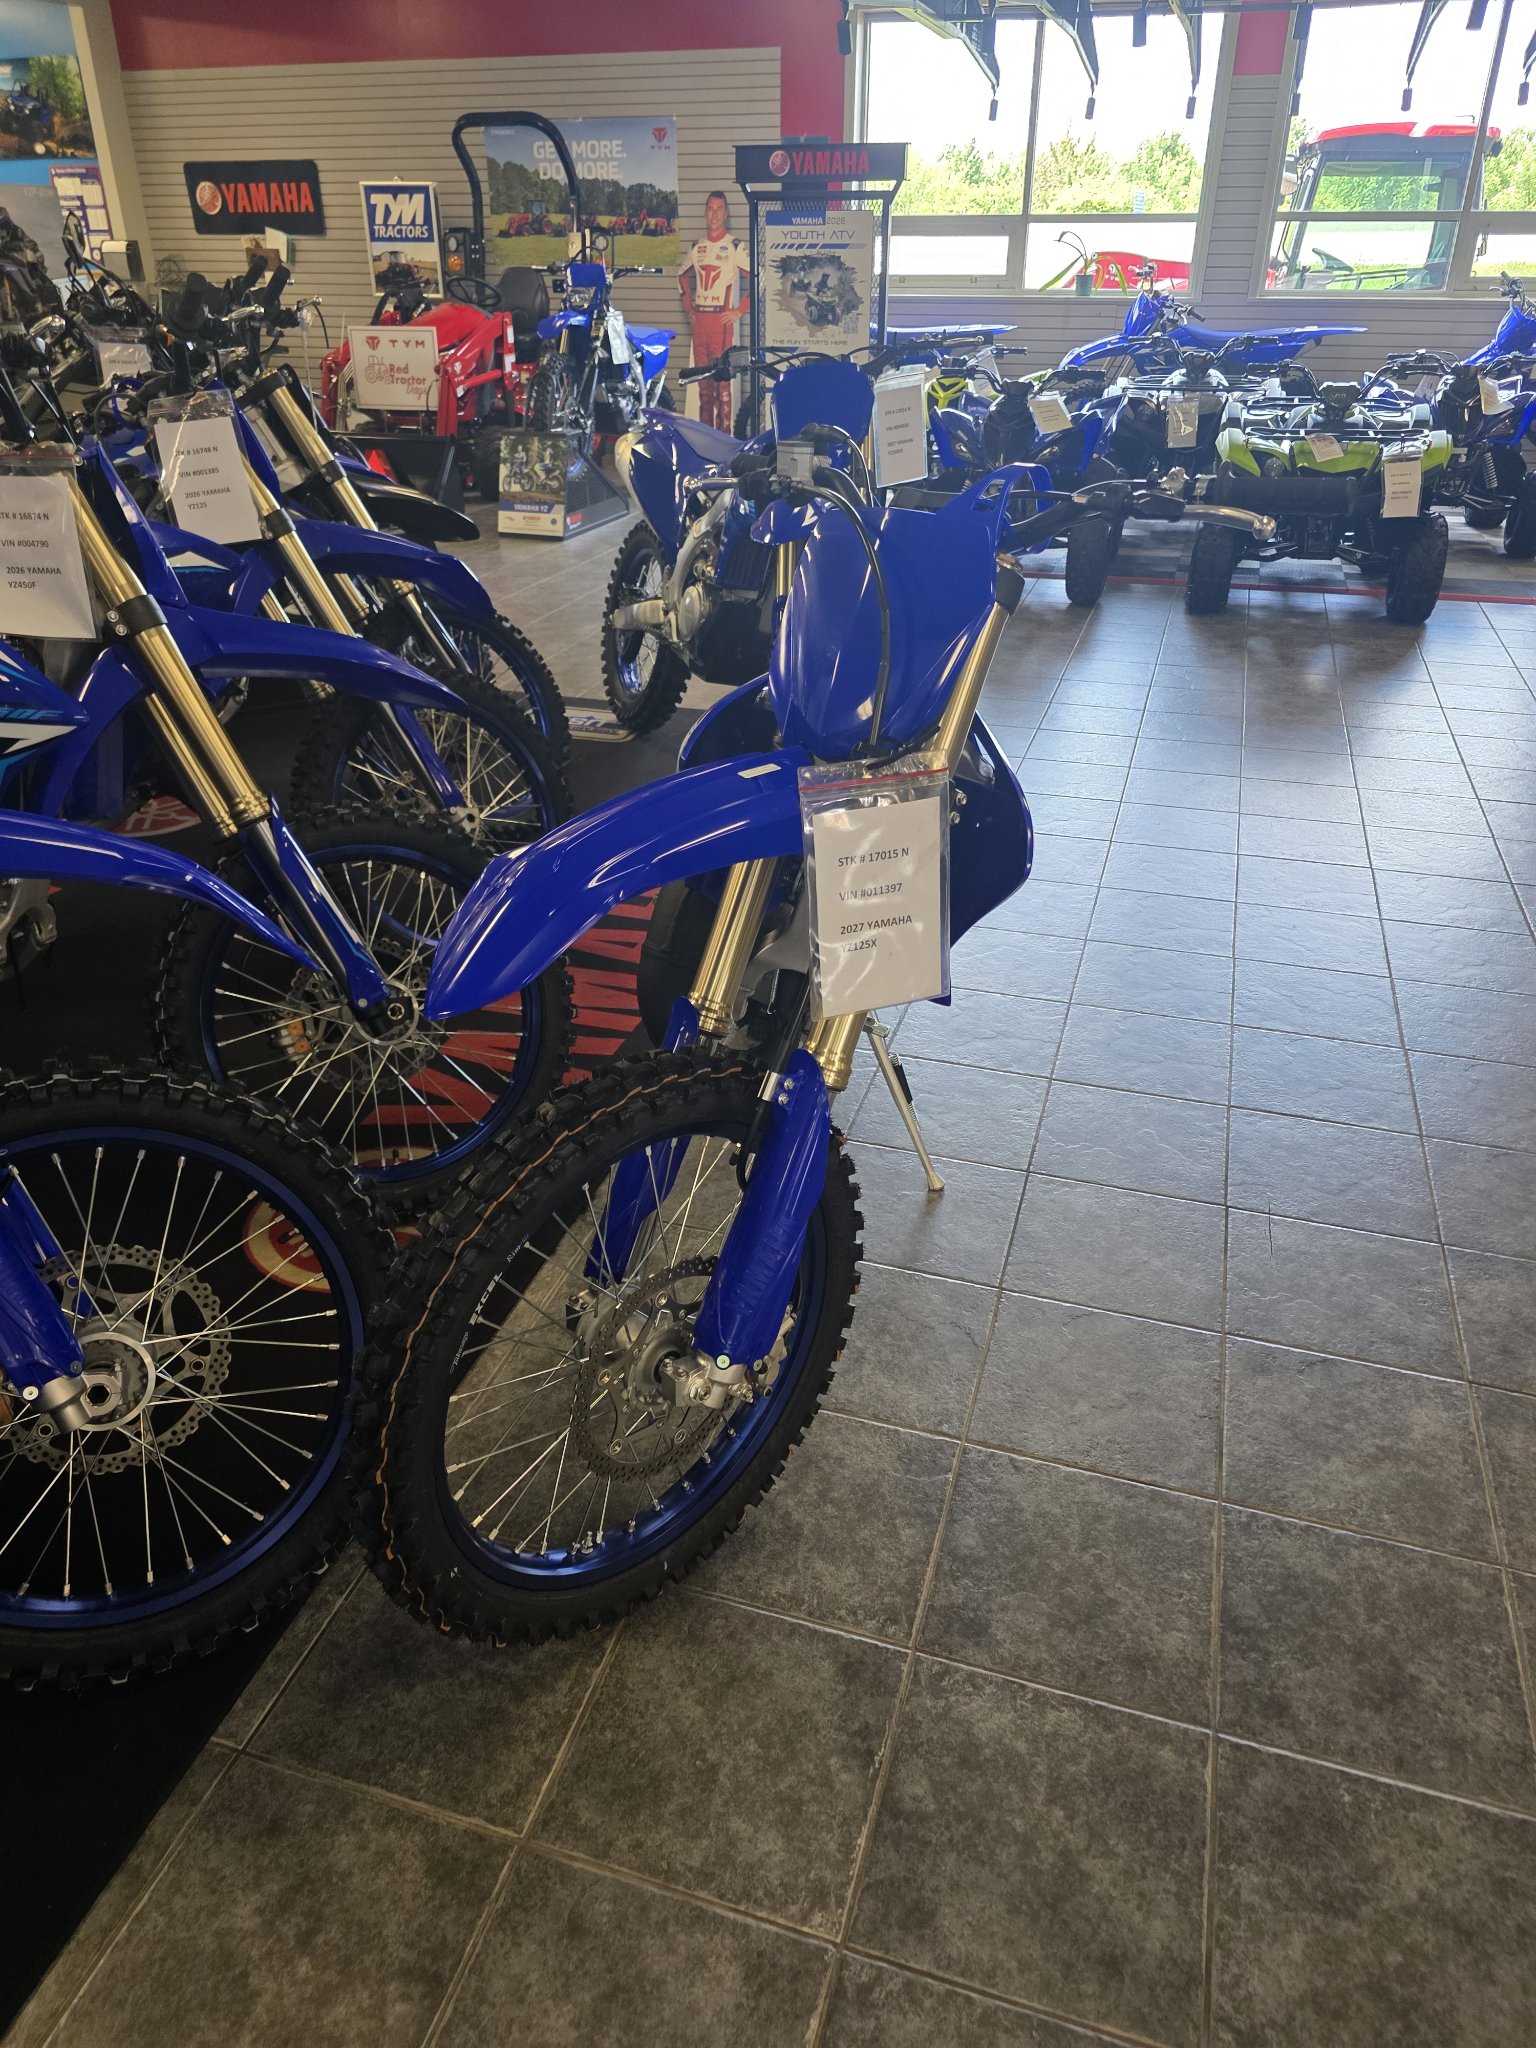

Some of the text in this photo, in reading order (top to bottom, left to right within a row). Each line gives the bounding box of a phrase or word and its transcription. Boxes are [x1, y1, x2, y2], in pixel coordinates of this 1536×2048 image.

[533, 139, 628, 159] GE MORE.
[791, 150, 869, 176] YAMAHA
[539, 161, 565, 180] DO
[221, 181, 315, 214] YAMAHA
[370, 193, 425, 225] TYM
[791, 216, 823, 225] YAMAHA
[373, 225, 429, 239] TRACTORS
[781, 230, 856, 240] YOUTH ATV
[388, 339, 425, 349] TYM
[389, 363, 409, 375] Red
[389, 375, 427, 386] Tractor
[406, 383, 427, 400] Days
[192, 447, 212, 456] 16748
[201, 487, 231, 497] YAMAHA
[187, 501, 208, 510] YZ125
[12, 512, 17, 520] #
[18, 512, 42, 520] 16874
[43, 512, 49, 520] N
[1, 539, 49, 548] VIN #004790
[6, 566, 62, 575] 2026 YAMAHA
[8, 581, 37, 589] YZ450F
[838, 847, 909, 867] STK # 17015 N
[839, 882, 903, 901] VIN #011397
[840, 914, 913, 935] 2027 YAMAHA
[841, 938, 878, 953] YZ125X
